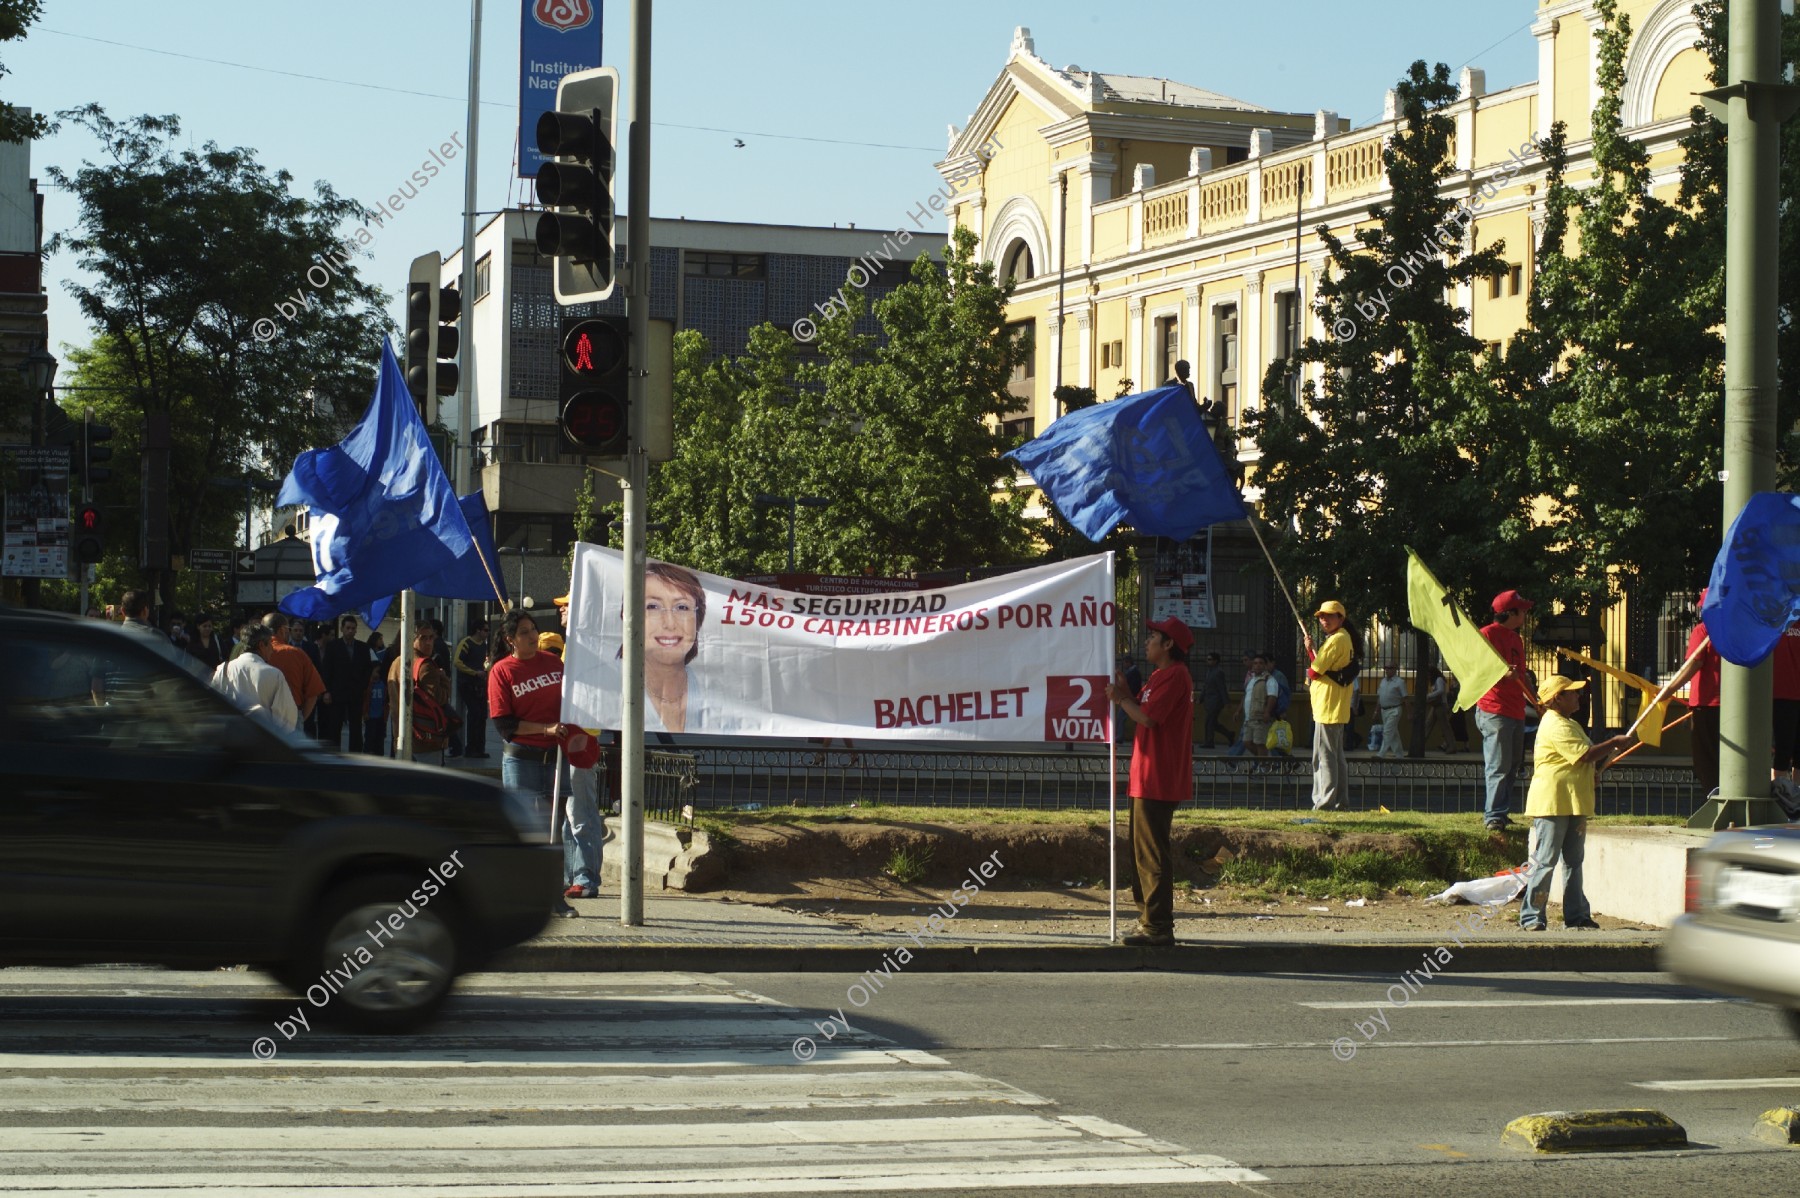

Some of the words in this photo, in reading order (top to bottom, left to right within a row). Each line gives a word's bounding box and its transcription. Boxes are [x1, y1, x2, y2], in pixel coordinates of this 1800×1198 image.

[806, 584, 846, 592] TURÍSTICO
[847, 586, 882, 594] CULTURAL
[819, 577, 849, 585] CENTRO
[851, 577, 860, 585] DE
[862, 578, 919, 588] INFORMACIONES
[727, 588, 785, 612] MÁS
[791, 593, 947, 616] SEGURIDAD
[721, 605, 795, 629] 1500
[803, 607, 990, 637] CARABINEROS
[998, 603, 1053, 629] POR
[1060, 595, 1116, 627] AÑO
[511, 671, 562, 698] BACHELET
[1067, 678, 1093, 718] 2
[874, 687, 1030, 730] BACHELET
[1052, 718, 1106, 740] VOTA
